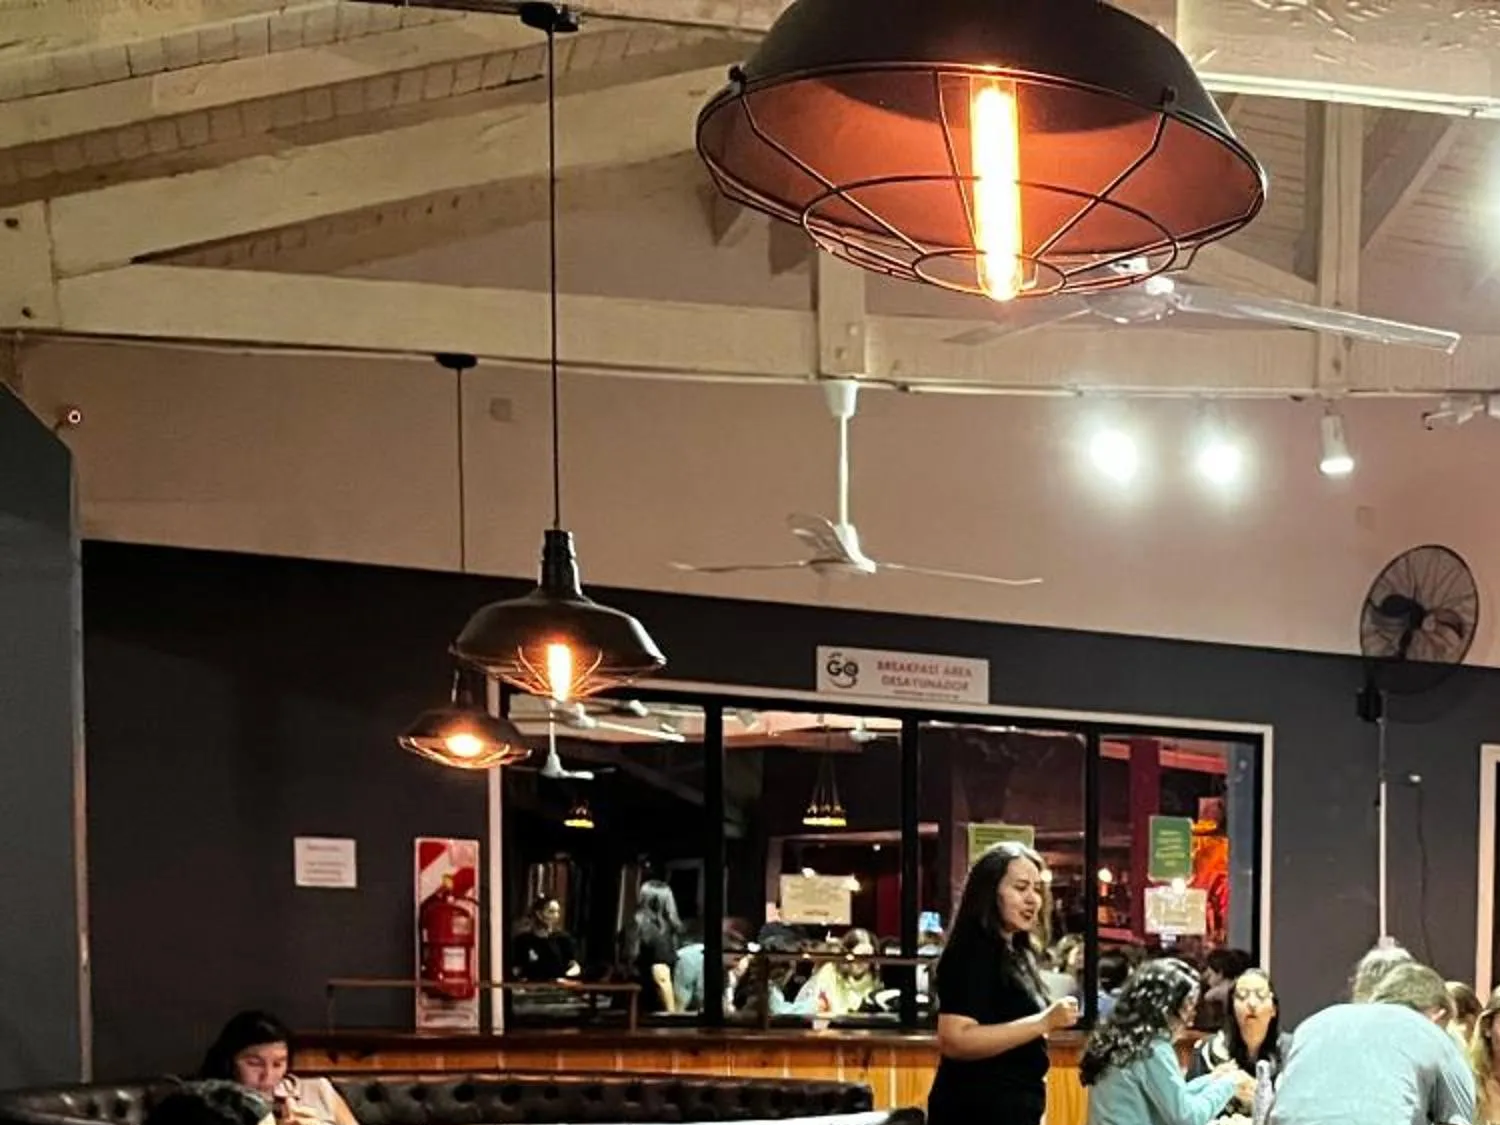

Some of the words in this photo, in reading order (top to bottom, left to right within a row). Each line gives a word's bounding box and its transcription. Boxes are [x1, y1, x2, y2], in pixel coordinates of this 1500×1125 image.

[877, 660, 939, 676] BREAKFAST
[941, 664, 973, 678] AREA
[881, 674, 969, 692] DESAYUNADOR
